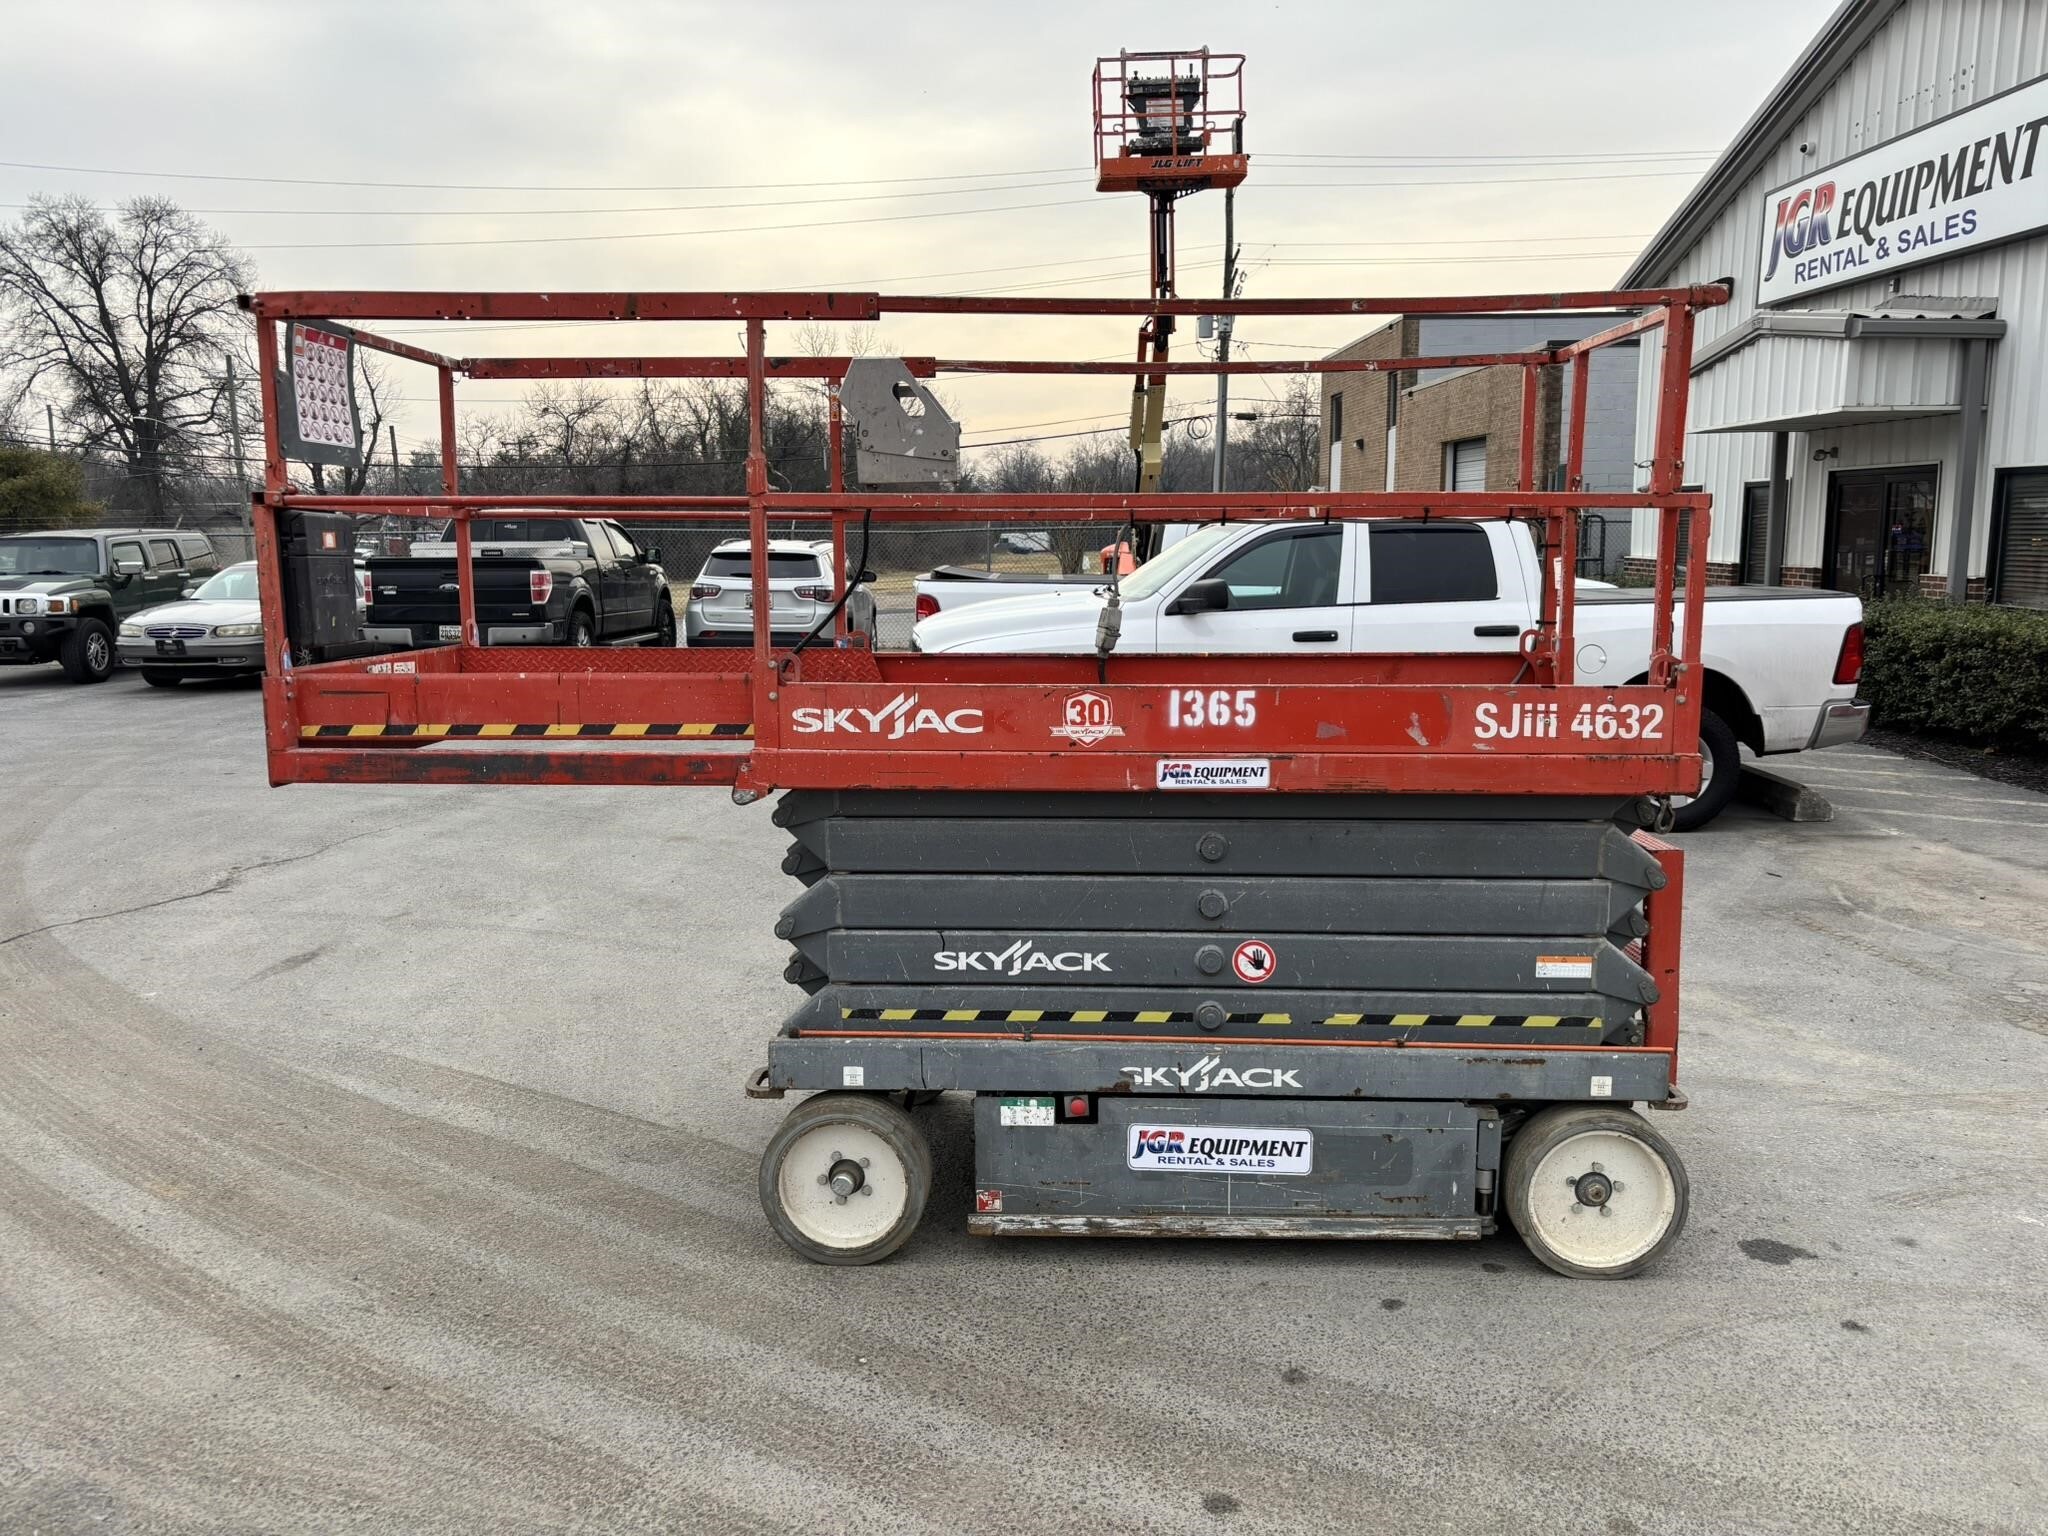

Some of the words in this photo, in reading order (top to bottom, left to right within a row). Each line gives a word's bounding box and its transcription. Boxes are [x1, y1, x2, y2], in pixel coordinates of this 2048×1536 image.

[1176, 158, 1203, 168] LIFT
[1764, 181, 1836, 282] JGR
[1836, 115, 2048, 246] EQUIPMENT
[1794, 244, 1869, 285] RENTAL
[1876, 236, 1890, 260] &
[1897, 209, 1977, 254] SALES
[1070, 699, 1105, 726] 30
[1169, 689, 1257, 728] 1365
[1474, 703, 1557, 739] SJiii
[1571, 703, 1663, 739] 4632
[1160, 763, 1192, 782] JGR
[1194, 766, 1267, 780] EQUIPMENT
[933, 940, 1112, 976] SKYJACK
[1132, 1130, 1185, 1159] JGR
[1188, 1137, 1308, 1159] EQUIPMENT
[1158, 1156, 1209, 1166] RENTAL
[1215, 1158, 1225, 1166] &
[1229, 1158, 1276, 1168] SALES
